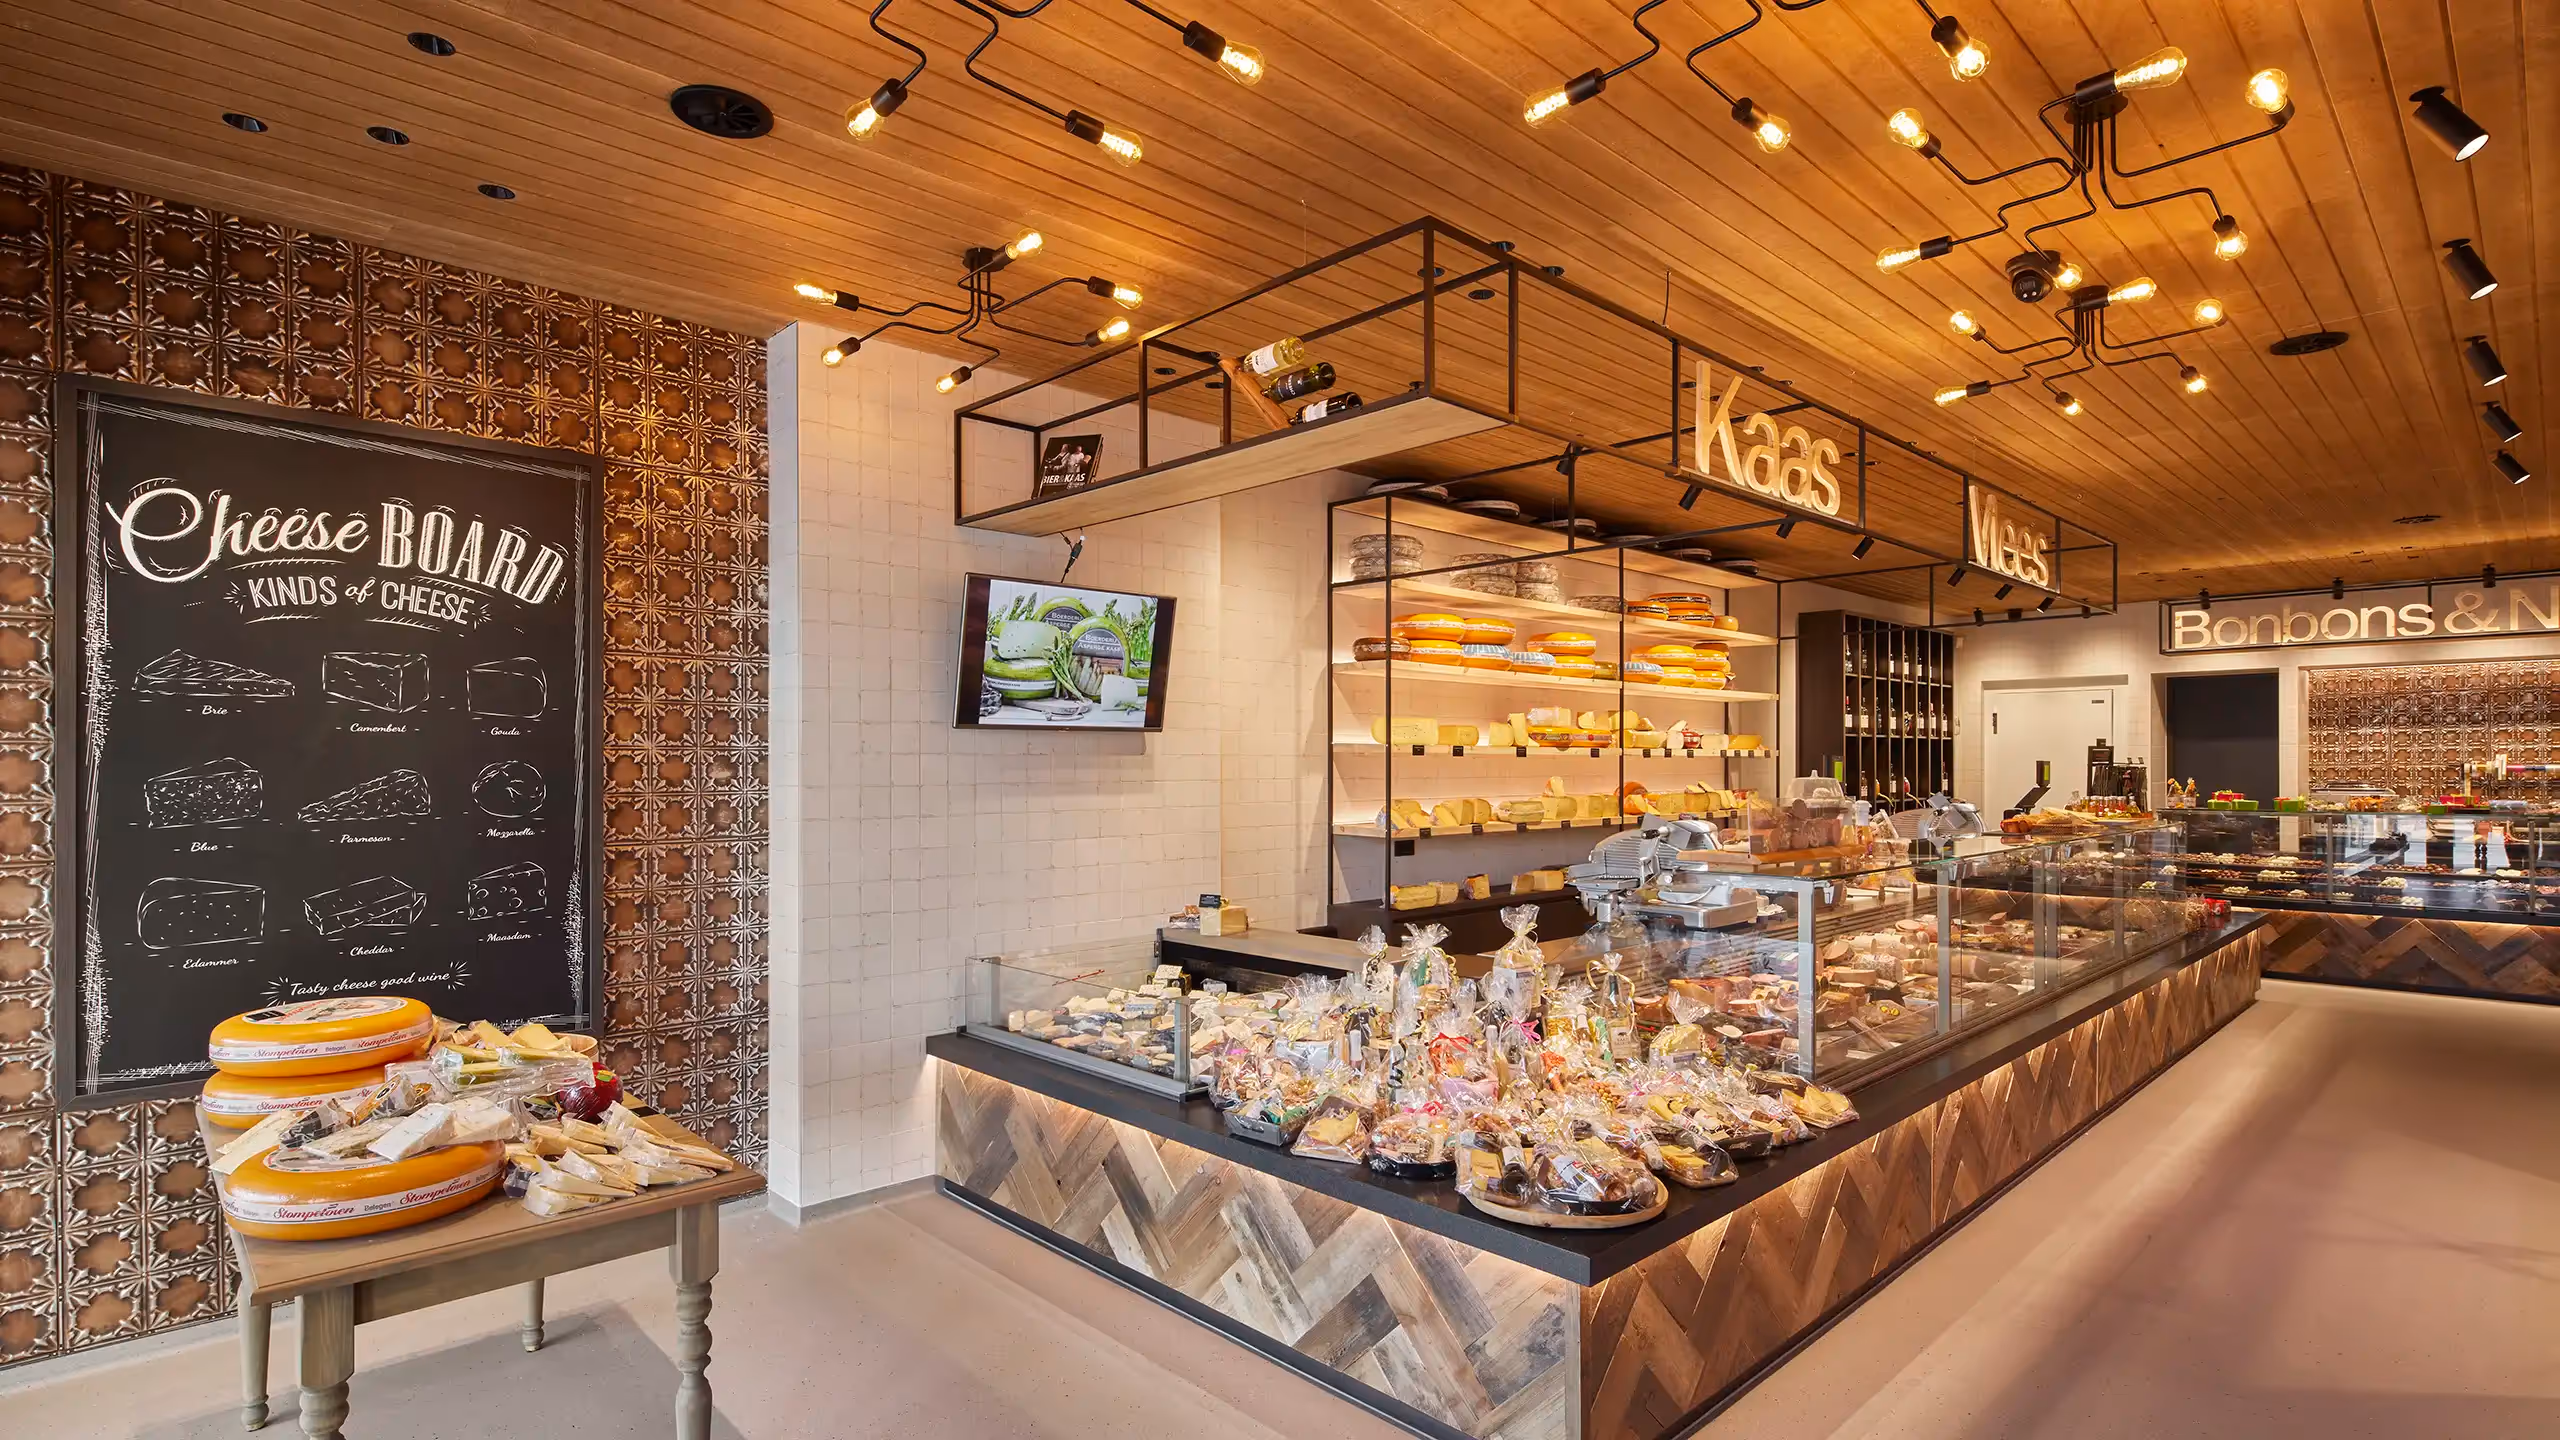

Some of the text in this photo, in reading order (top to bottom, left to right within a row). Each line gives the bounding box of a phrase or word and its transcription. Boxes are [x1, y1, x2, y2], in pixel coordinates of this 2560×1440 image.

[1695, 360, 1841, 516] Kaas
[1969, 485, 2049, 587] Vlees
[105, 487, 565, 605] Cheese BOARD
[248, 576, 475, 625] KINDS of CHEESE
[2174, 602, 2433, 649] Bonbons
[2443, 590, 2500, 634] &
[201, 704, 229, 715] Brie
[349, 722, 407, 734] Camembert
[490, 726, 521, 736] Gouda
[340, 833, 392, 844] Parmesan
[486, 827, 536, 838] Mozzarella
[190, 841, 219, 853] Blue
[486, 931, 532, 942] Maasdam
[349, 944, 394, 957] Cheddar
[182, 957, 240, 969] Edammer
[289, 968, 451, 997] Tasty cheese good wine
[273, 1205, 355, 1221] Stompetoren
[363, 1201, 392, 1212] Belegen
[400, 1179, 471, 1205] Stompetoren
